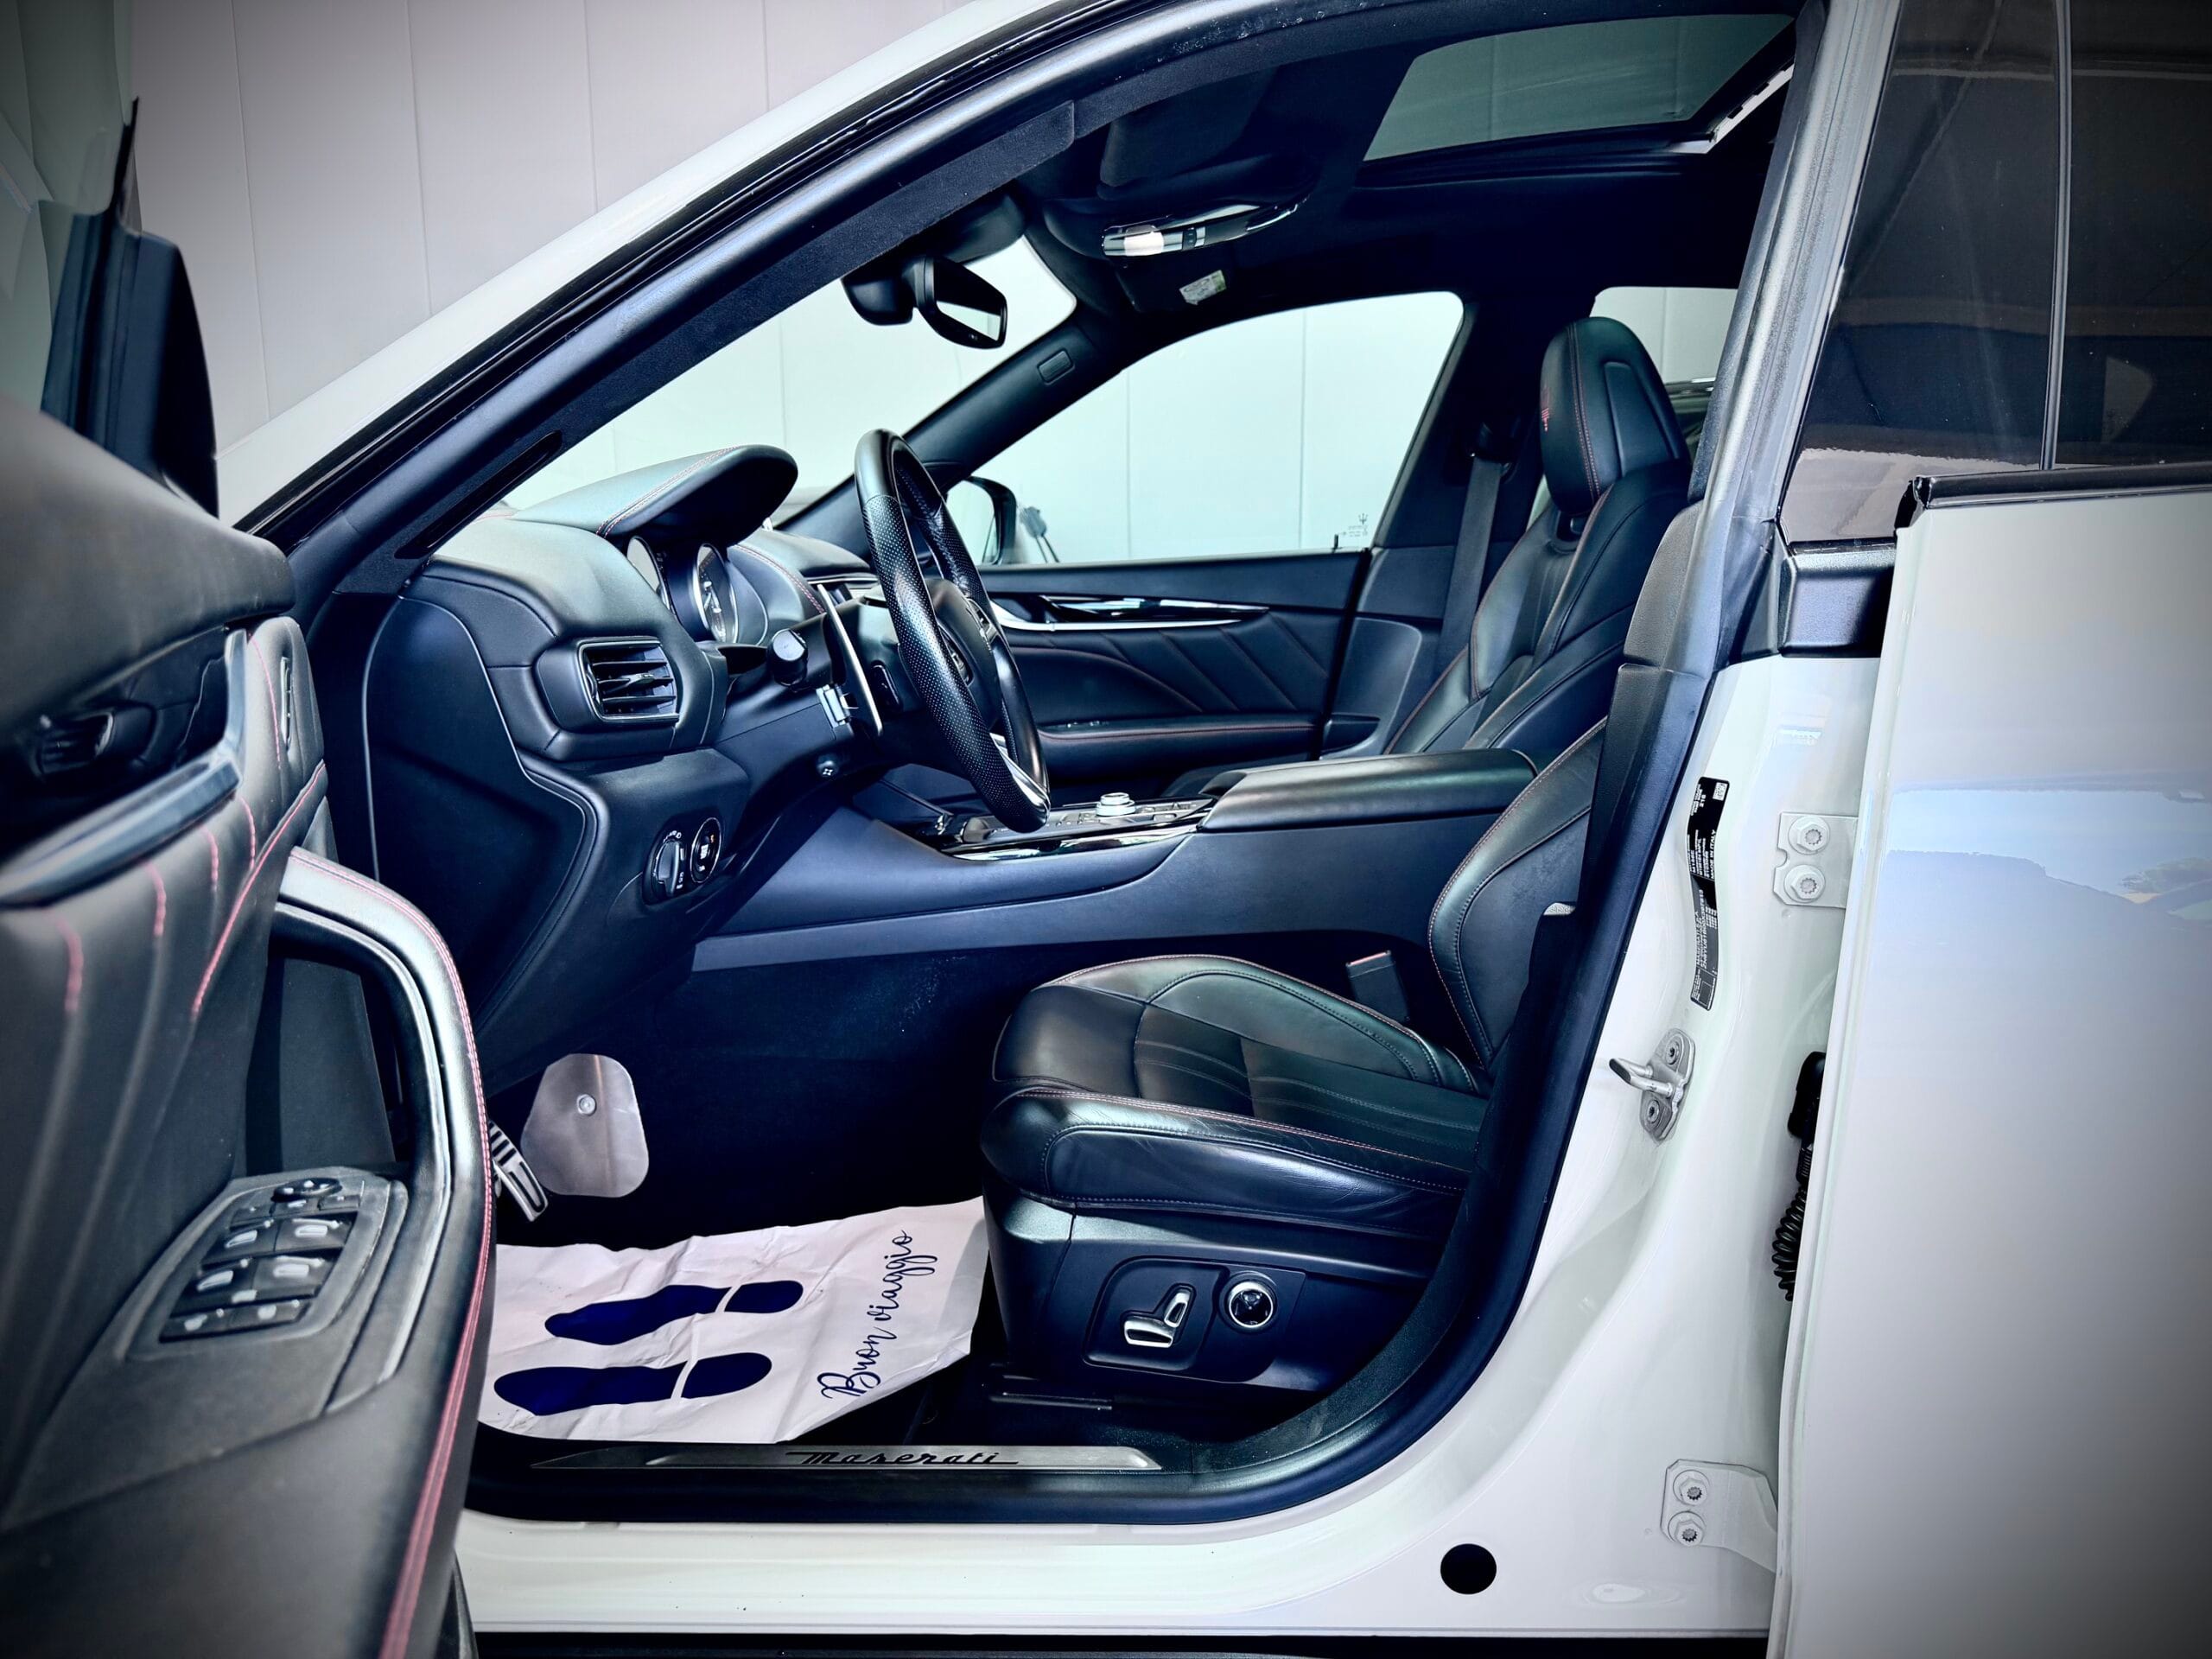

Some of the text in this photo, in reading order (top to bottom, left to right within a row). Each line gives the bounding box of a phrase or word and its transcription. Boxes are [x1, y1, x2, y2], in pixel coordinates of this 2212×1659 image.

[817, 1230, 938, 1399] Buon viaggio
[785, 1450, 1019, 1466] Maserati
